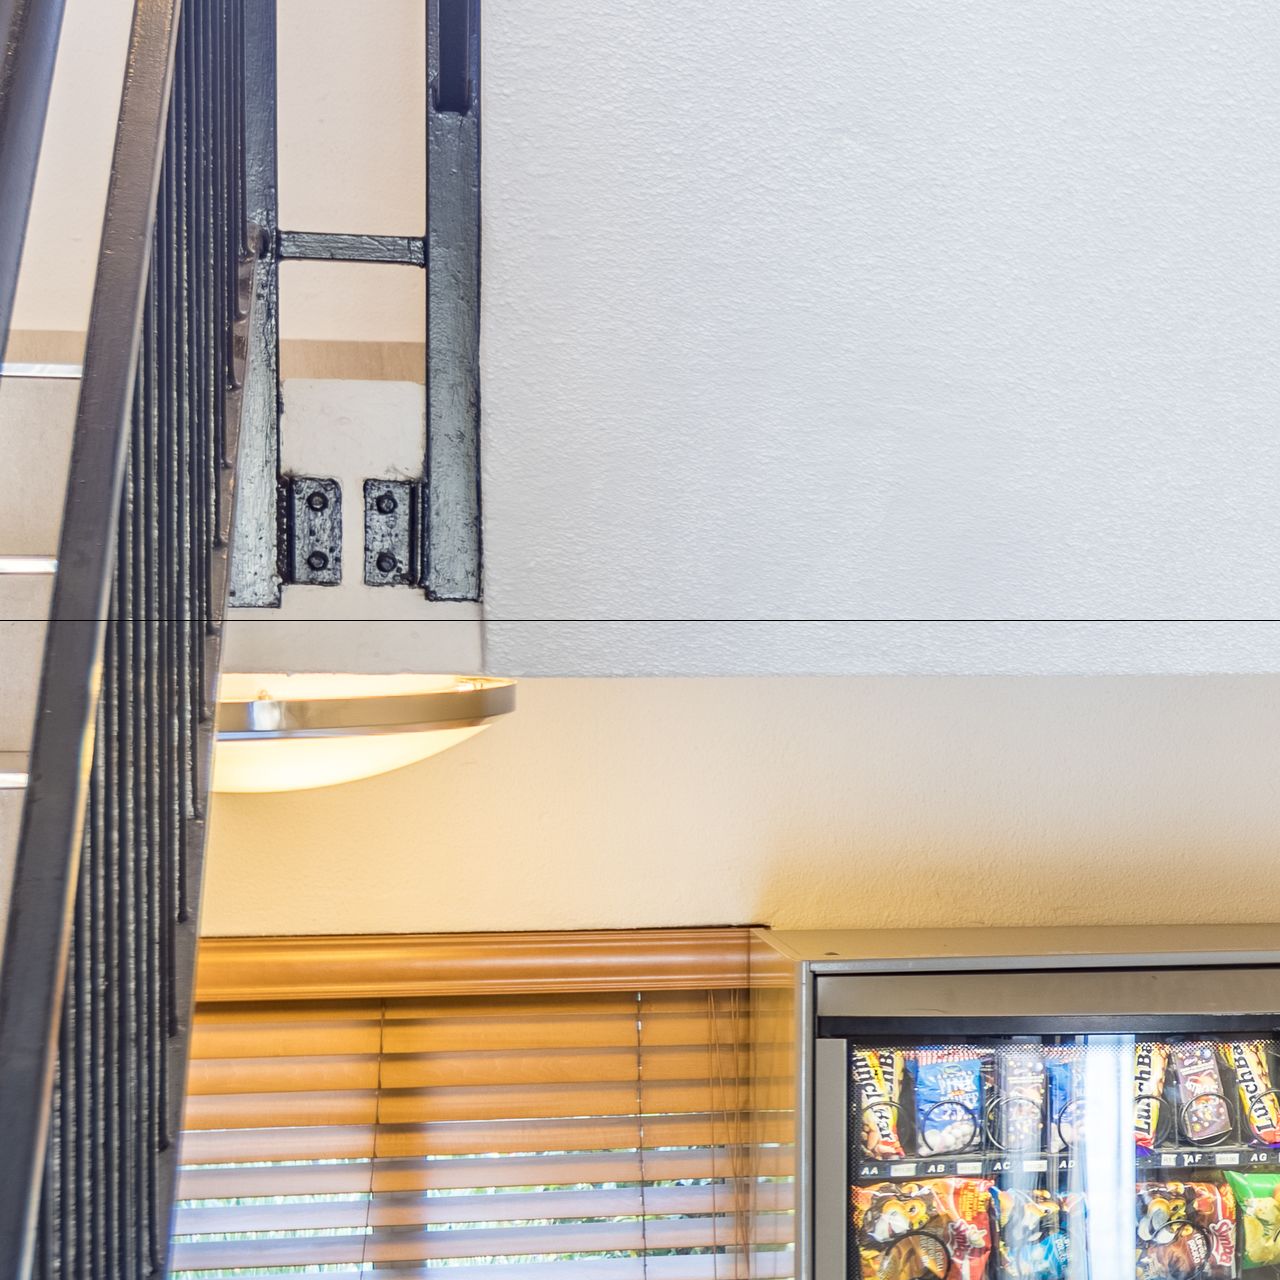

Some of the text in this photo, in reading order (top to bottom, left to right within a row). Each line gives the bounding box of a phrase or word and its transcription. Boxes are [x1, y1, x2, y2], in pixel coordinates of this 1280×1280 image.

[1250, 1153, 1268, 1163] AG
[861, 1166, 879, 1176] AA
[927, 1164, 946, 1173] AB
[992, 1161, 1013, 1171] AC
